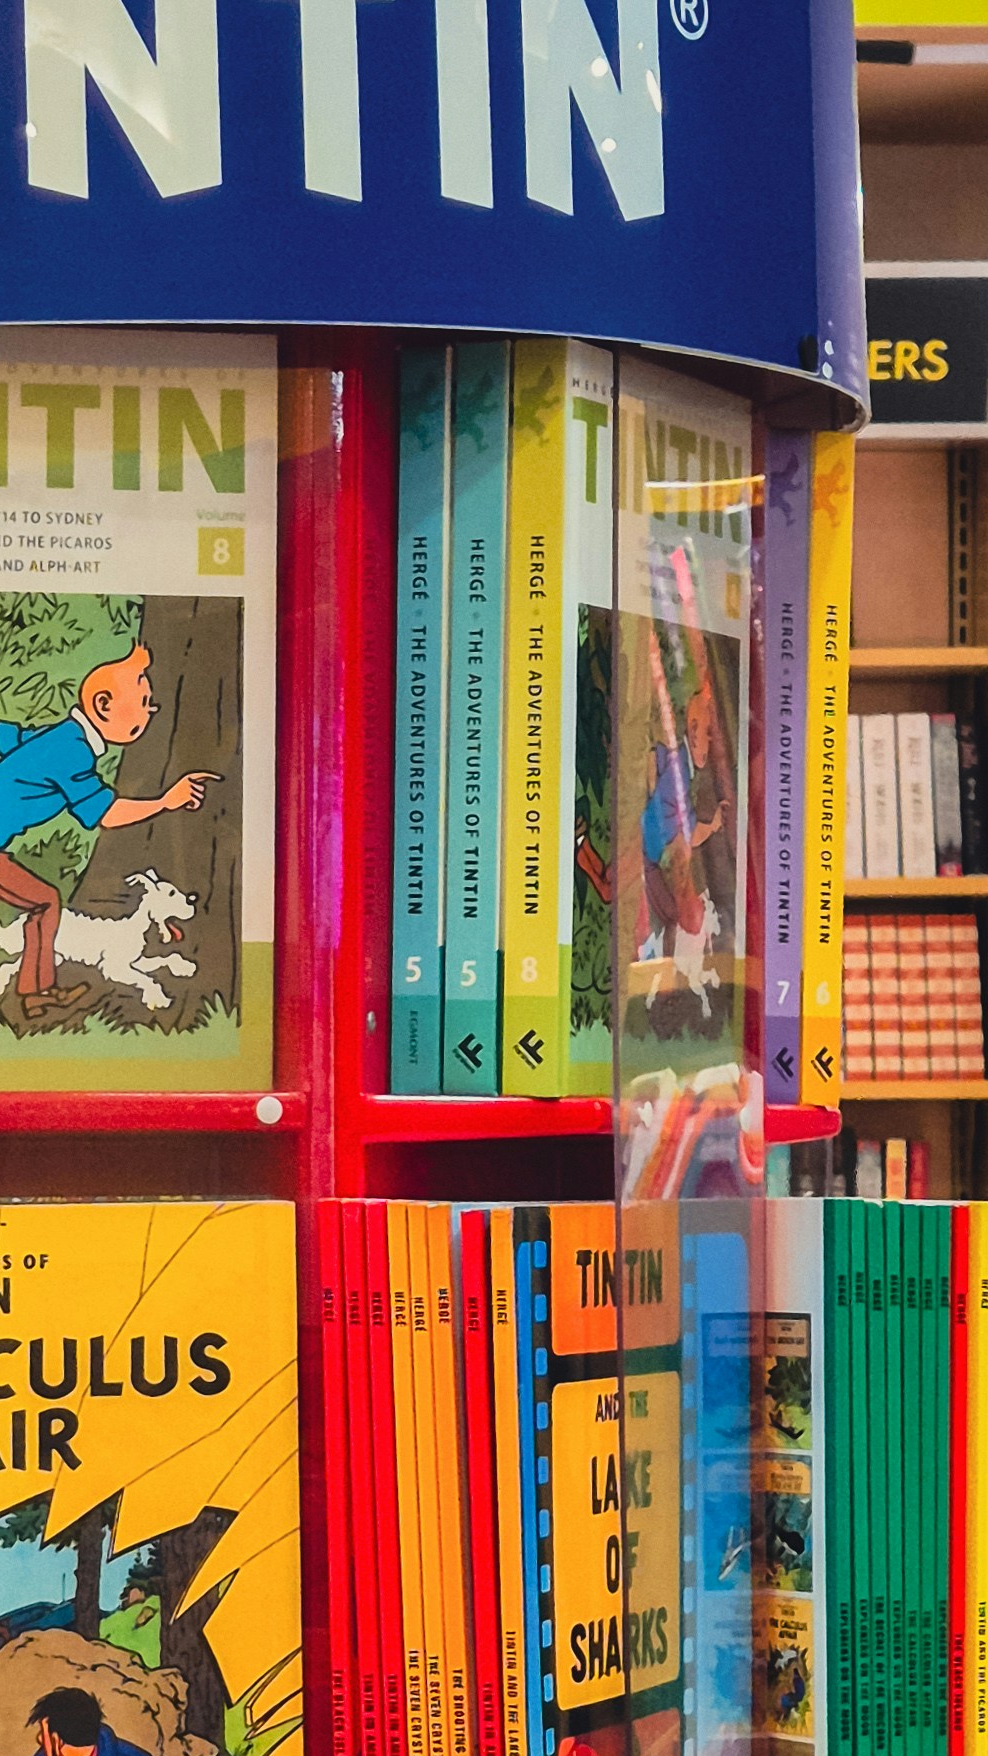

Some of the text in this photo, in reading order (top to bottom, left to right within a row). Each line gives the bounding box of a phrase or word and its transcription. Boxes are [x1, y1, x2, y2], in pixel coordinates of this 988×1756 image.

[868, 340, 949, 382] ERS
[573, 396, 743, 544] TINTIN
[21, 511, 43, 525] TO
[45, 511, 104, 526] SYDNEY
[16, 535, 46, 549] THE
[50, 535, 113, 551] PICAROS
[212, 537, 232, 564] 8
[29, 558, 102, 574] ALPH-ART
[405, 536, 429, 983] HERGÉ THE ADVENTURES OF TINTIN 5
[460, 538, 487, 987] HERGÉ THE ADVENTURES OF TINTIN 5
[521, 535, 547, 983] HERGÉ THE ADVENTURES OF TINTIN 8
[776, 603, 794, 1005] HERGÉ THE ADVENTURES OF TINTIN 7
[815, 605, 838, 1006] HERGÉ THE ADVENTURES OF TINTIN 6
[408, 1010, 419, 1065] EGMONT
[23, 1254, 49, 1270] OF
[575, 1249, 664, 1308] TINTIN
[595, 1390, 649, 1423] AND THE
[591, 1449, 652, 1515] LAKE
[606, 1530, 640, 1594] OF
[408, 1650, 420, 1669] THE
[505, 1631, 517, 1670] TINTIN
[571, 1606, 668, 1684] SHARKS
[428, 1655, 439, 1675] THE
[452, 1669, 464, 1689] THE
[409, 1675, 421, 1711] SEVEN
[429, 1681, 441, 1718] SEVEN
[507, 1675, 519, 1698] AND
[453, 1695, 466, 1753] SHOOTING
[507, 1704, 519, 1724] THE
